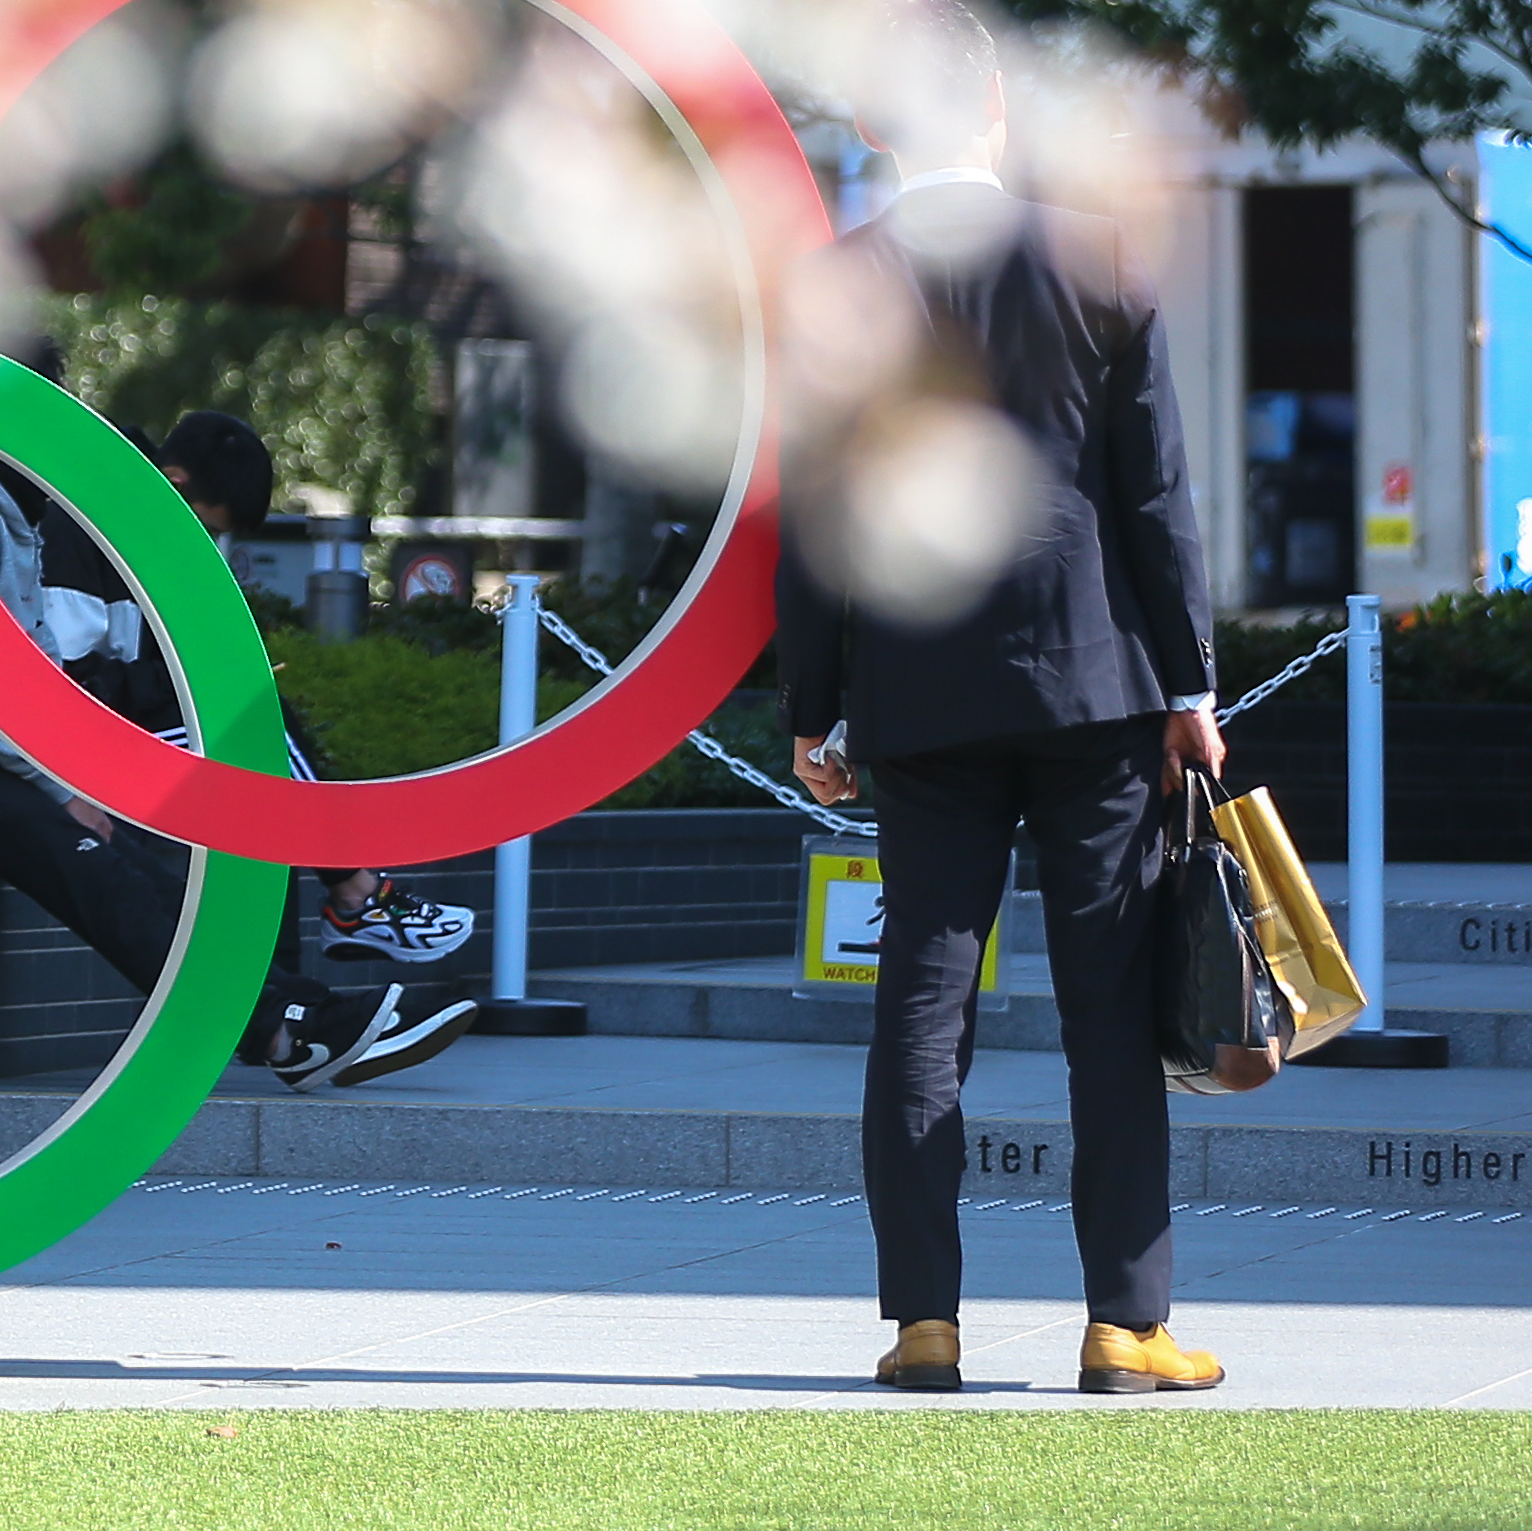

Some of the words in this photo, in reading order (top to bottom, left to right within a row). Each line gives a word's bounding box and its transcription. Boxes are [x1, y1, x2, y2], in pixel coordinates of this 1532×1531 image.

[1459, 918, 1531, 952] Citi
[823, 967, 876, 982] WATCH
[964, 1135, 1049, 1174] ter
[1369, 1141, 1525, 1187] Higher
